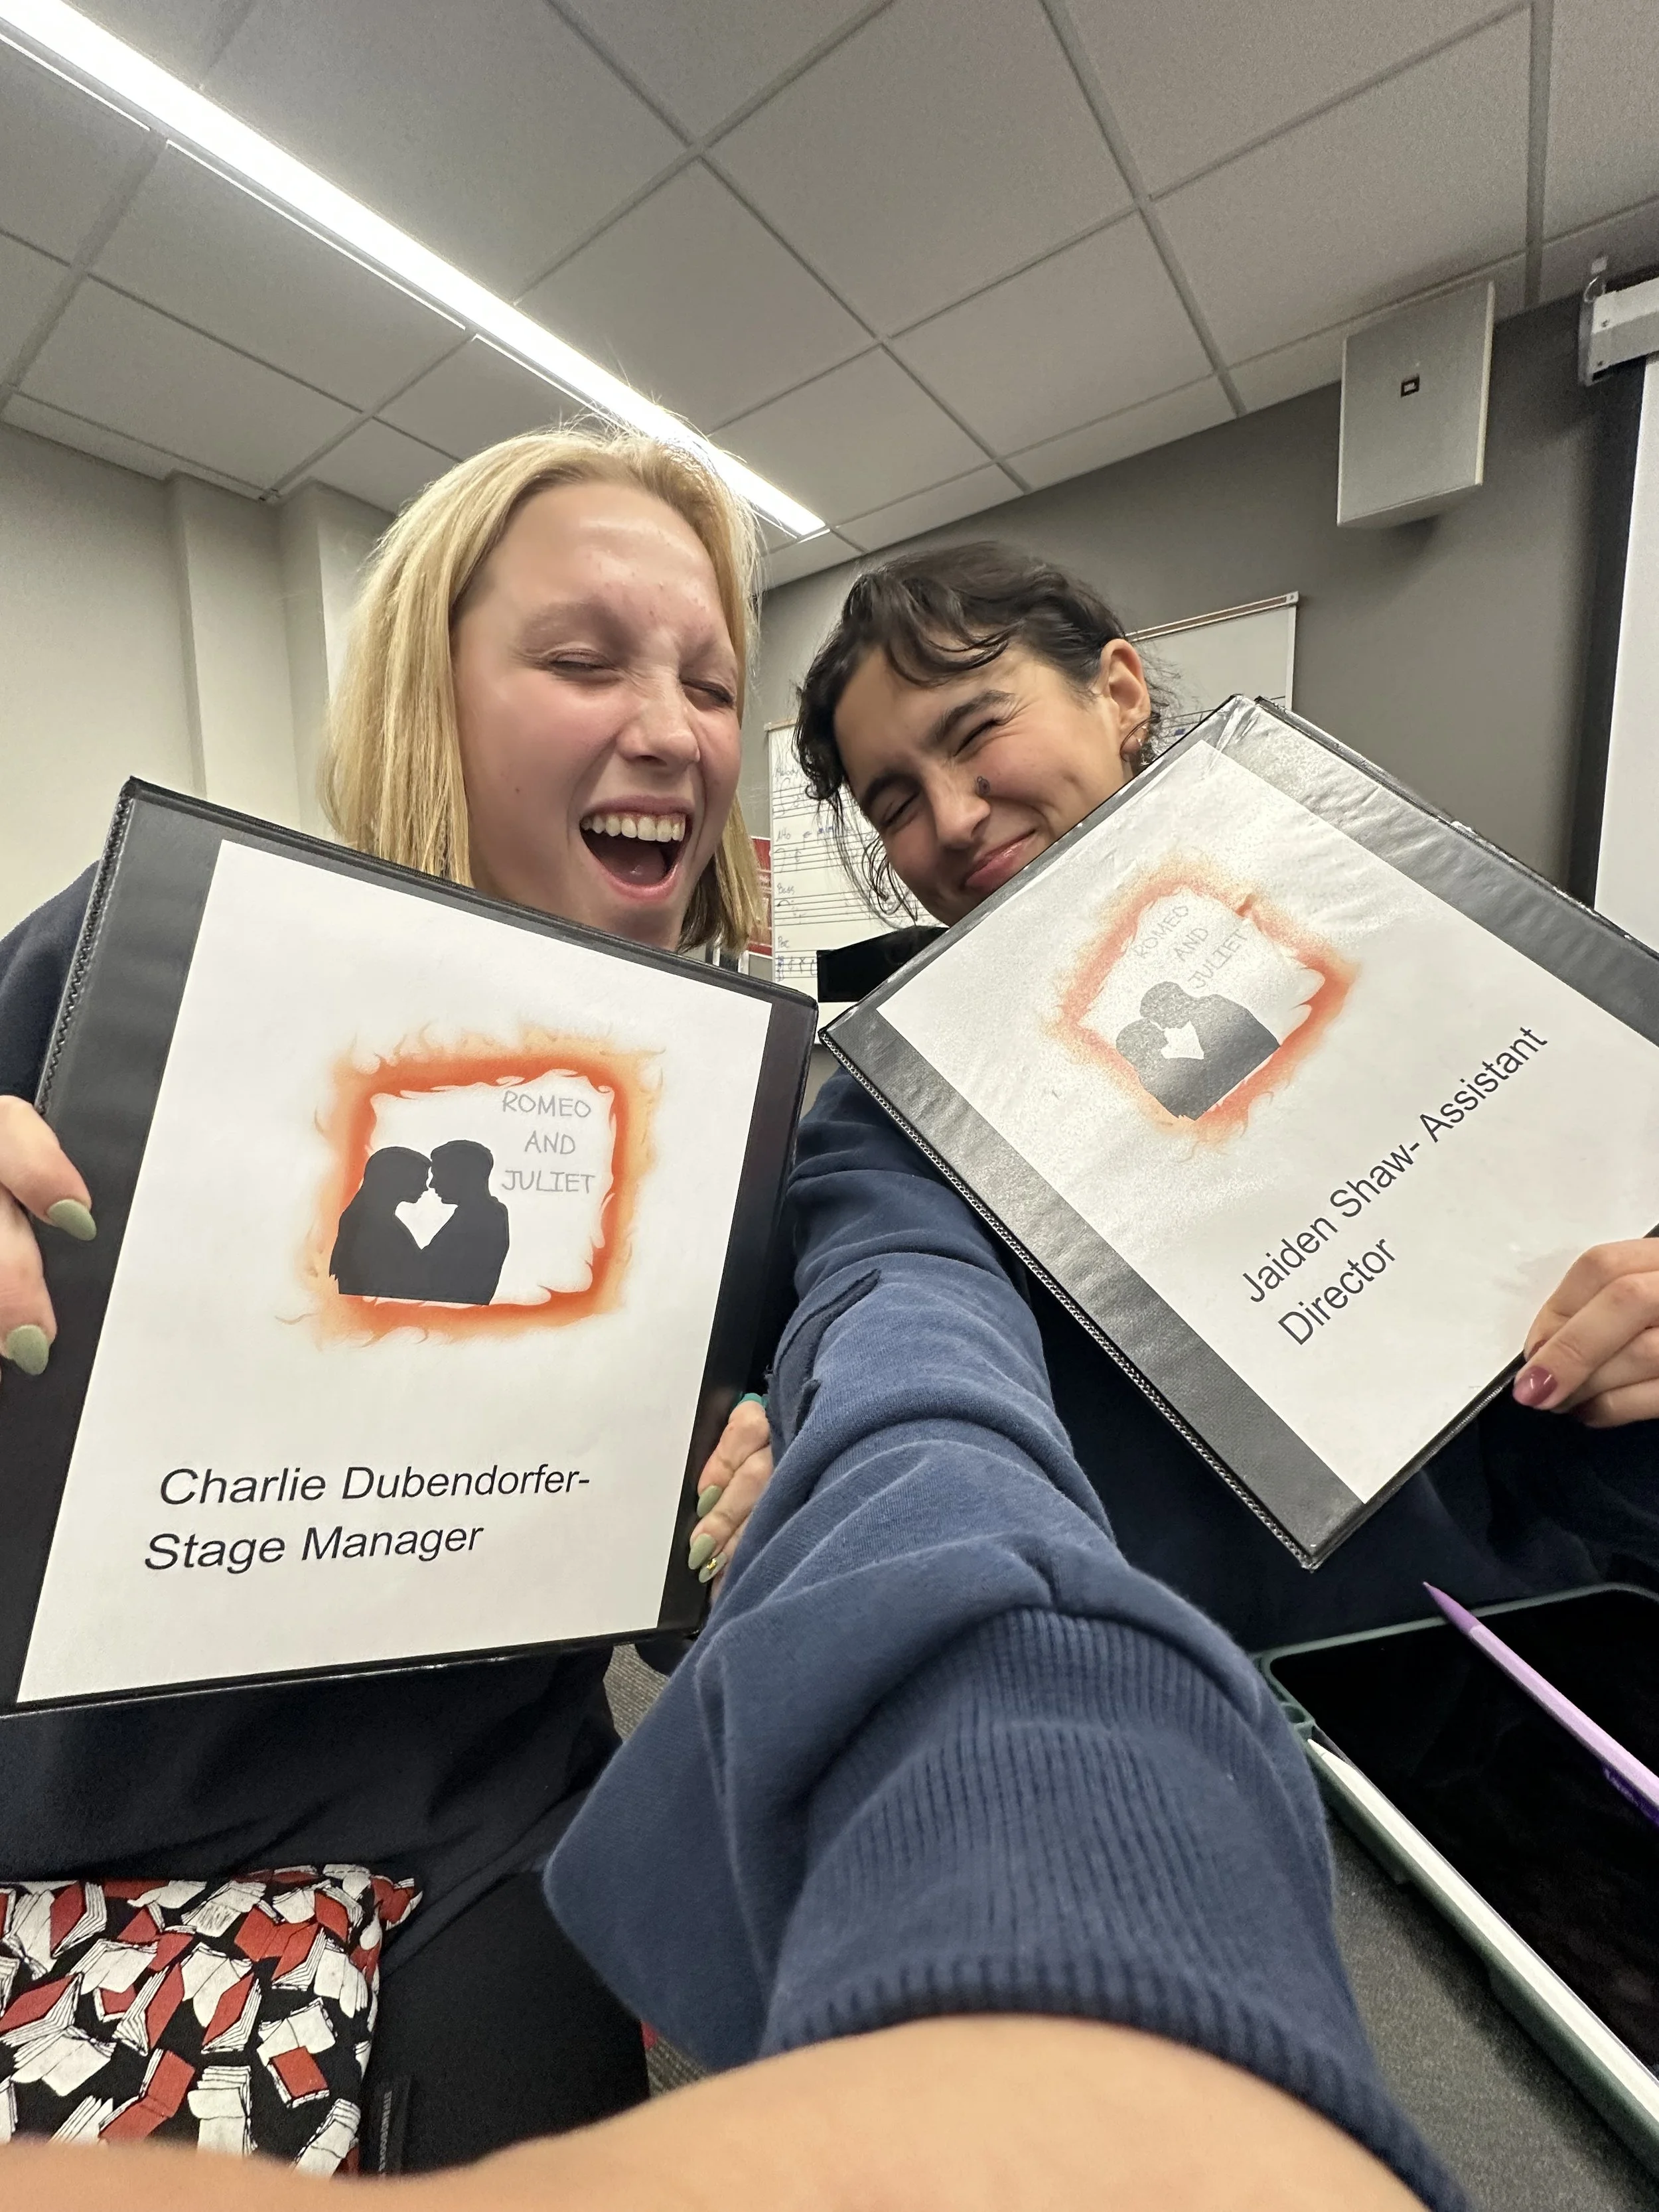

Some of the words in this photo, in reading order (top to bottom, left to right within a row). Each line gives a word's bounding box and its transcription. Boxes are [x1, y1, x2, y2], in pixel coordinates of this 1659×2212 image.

[1132, 905, 1189, 958] ROMEO
[1174, 928, 1208, 962] AND
[1188, 928, 1248, 989] JULIET
[502, 1090, 592, 1118] ROMEO
[524, 1130, 576, 1155] AND
[1242, 1216, 1338, 1303] Jaiden
[1329, 1142, 1420, 1218] Shaw-
[1419, 1026, 1548, 1143] Assistant
[501, 1169, 596, 1195] JULIET
[1277, 1238, 1396, 1346] Director
[161, 1467, 326, 1505] Charlie
[342, 1463, 590, 1499] Dubendorfer-
[145, 1533, 285, 1574] Stage
[301, 1526, 484, 1562] Manager
